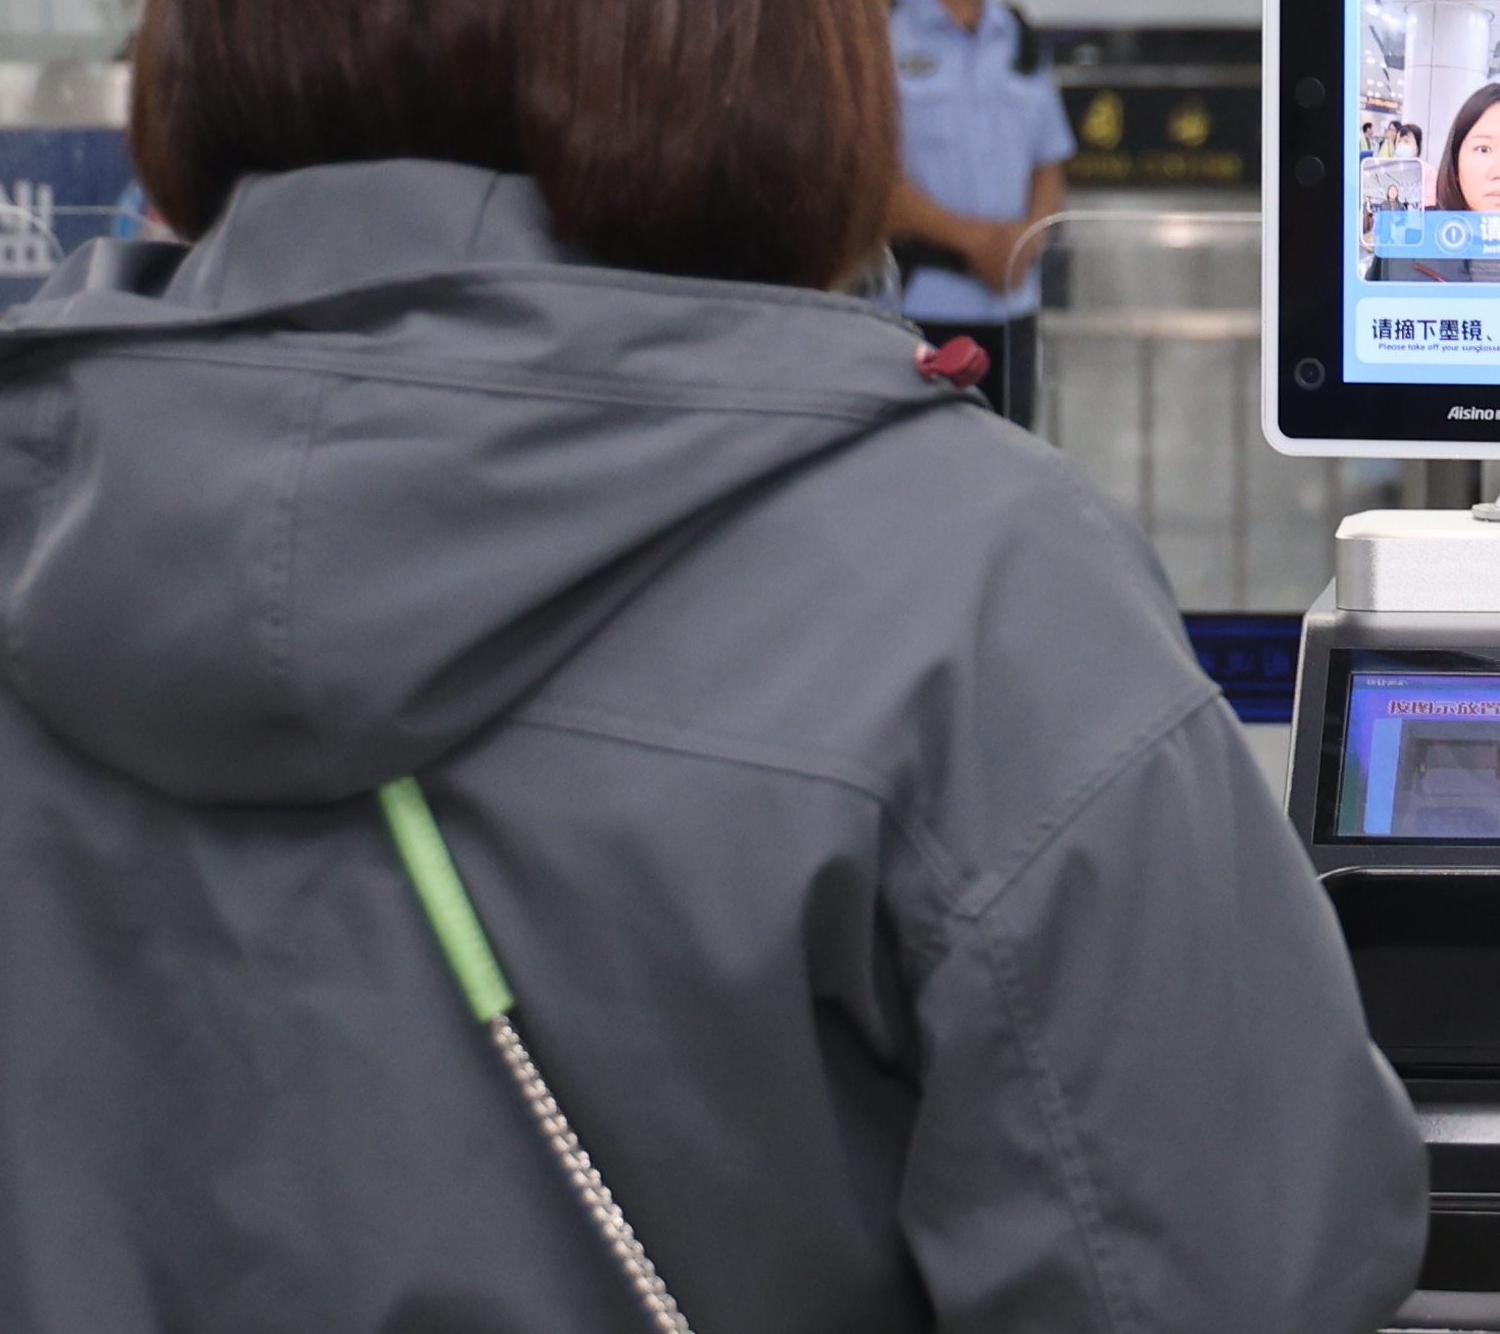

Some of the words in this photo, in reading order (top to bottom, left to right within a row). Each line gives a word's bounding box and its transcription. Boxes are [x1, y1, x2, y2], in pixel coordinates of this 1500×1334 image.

[1378, 343, 1406, 351] Please
[1407, 343, 1426, 351] take
[1428, 343, 1439, 351] off
[1441, 344, 1460, 353] your
[1447, 406, 1494, 421] Aisino
